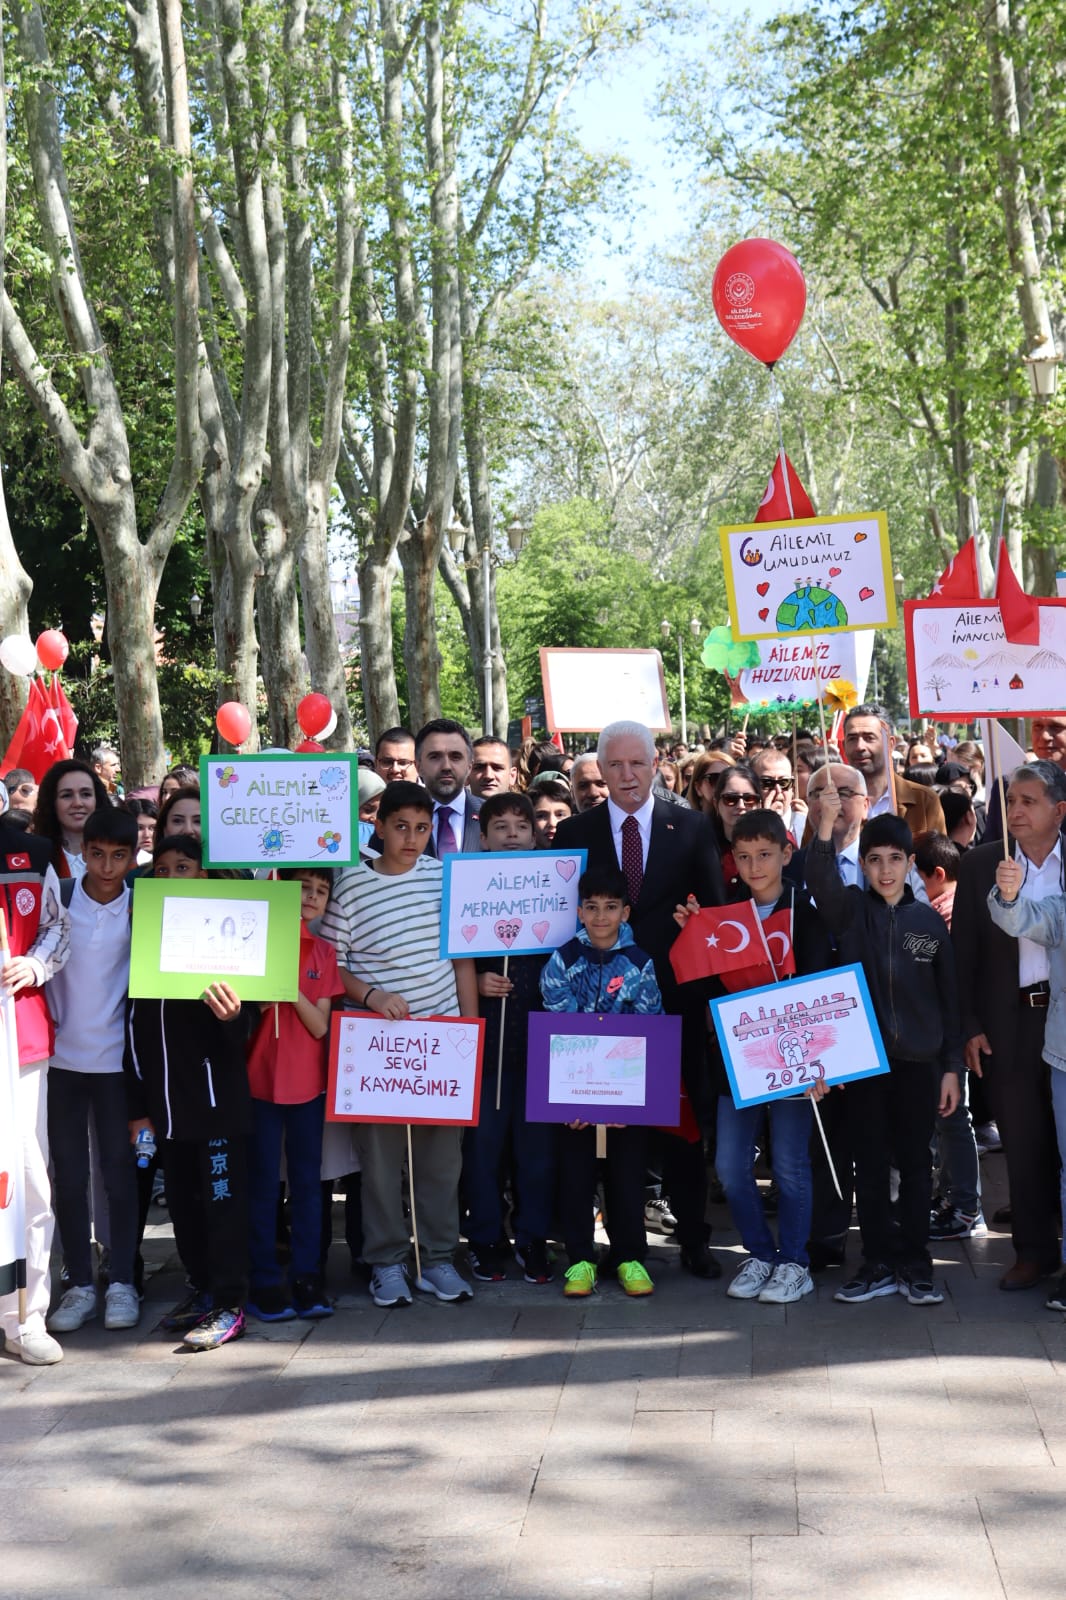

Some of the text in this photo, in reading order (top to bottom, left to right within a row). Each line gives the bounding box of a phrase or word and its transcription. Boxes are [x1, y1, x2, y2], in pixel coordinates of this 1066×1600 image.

[770, 532, 835, 551] AİLEMİZ
[764, 551, 852, 571] UMUDUMUZ
[955, 611, 1002, 627] AİLEMİ
[952, 630, 1006, 643] İNANCIM
[768, 642, 830, 662] AİLEMİZ
[752, 665, 841, 683] HUZURUMUZ
[246, 773, 321, 796] AİLEMİZ
[220, 802, 332, 826] GELECEĞİMİZ
[486, 870, 551, 891] AİLEMİZ
[460, 892, 568, 918] MERHAMETİMİZ
[368, 1030, 441, 1055] AİLEMİZ
[383, 1055, 427, 1071] SEVGİ
[360, 1075, 461, 1097] KAYNAĞIMIZ
